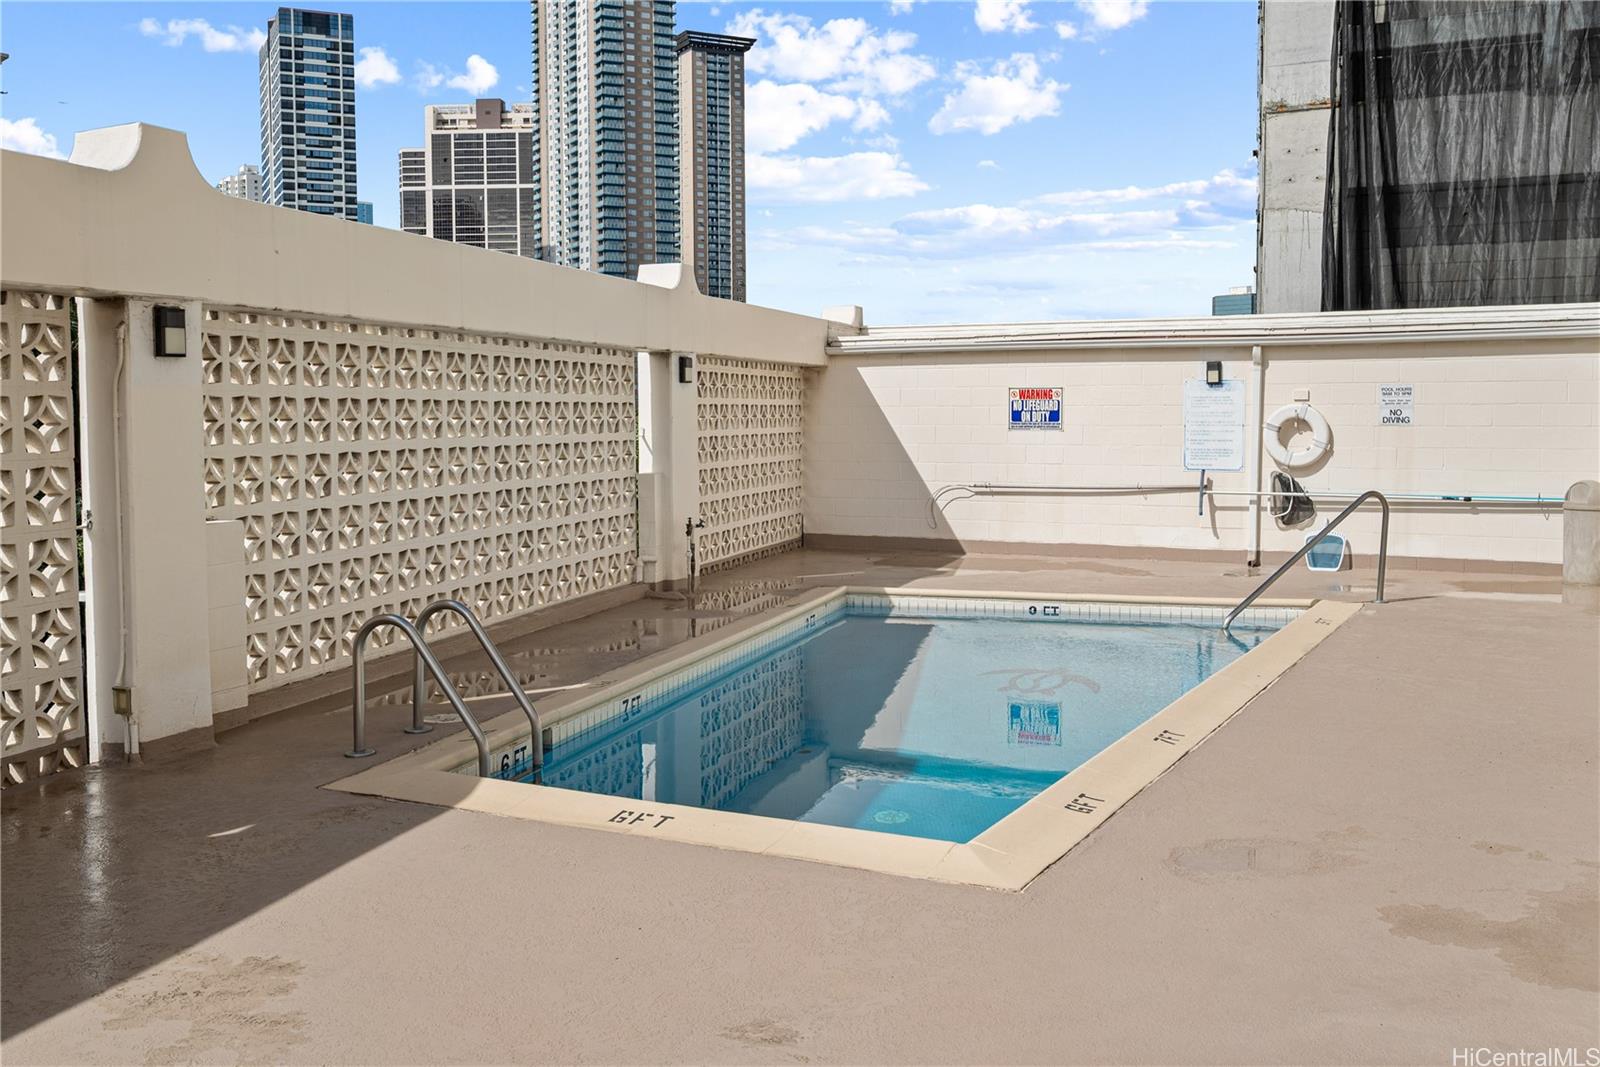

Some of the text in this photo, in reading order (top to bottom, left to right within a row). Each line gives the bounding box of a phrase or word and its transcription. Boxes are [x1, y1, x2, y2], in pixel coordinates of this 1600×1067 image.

[1018, 389, 1053, 400] WARNING
[1012, 400, 1059, 411] NO LIFEGUARD
[1021, 411, 1051, 422] ON DUTY
[1389, 409, 1403, 417] NO
[1382, 416, 1410, 424] DIVING
[501, 745, 528, 771] 6 FT
